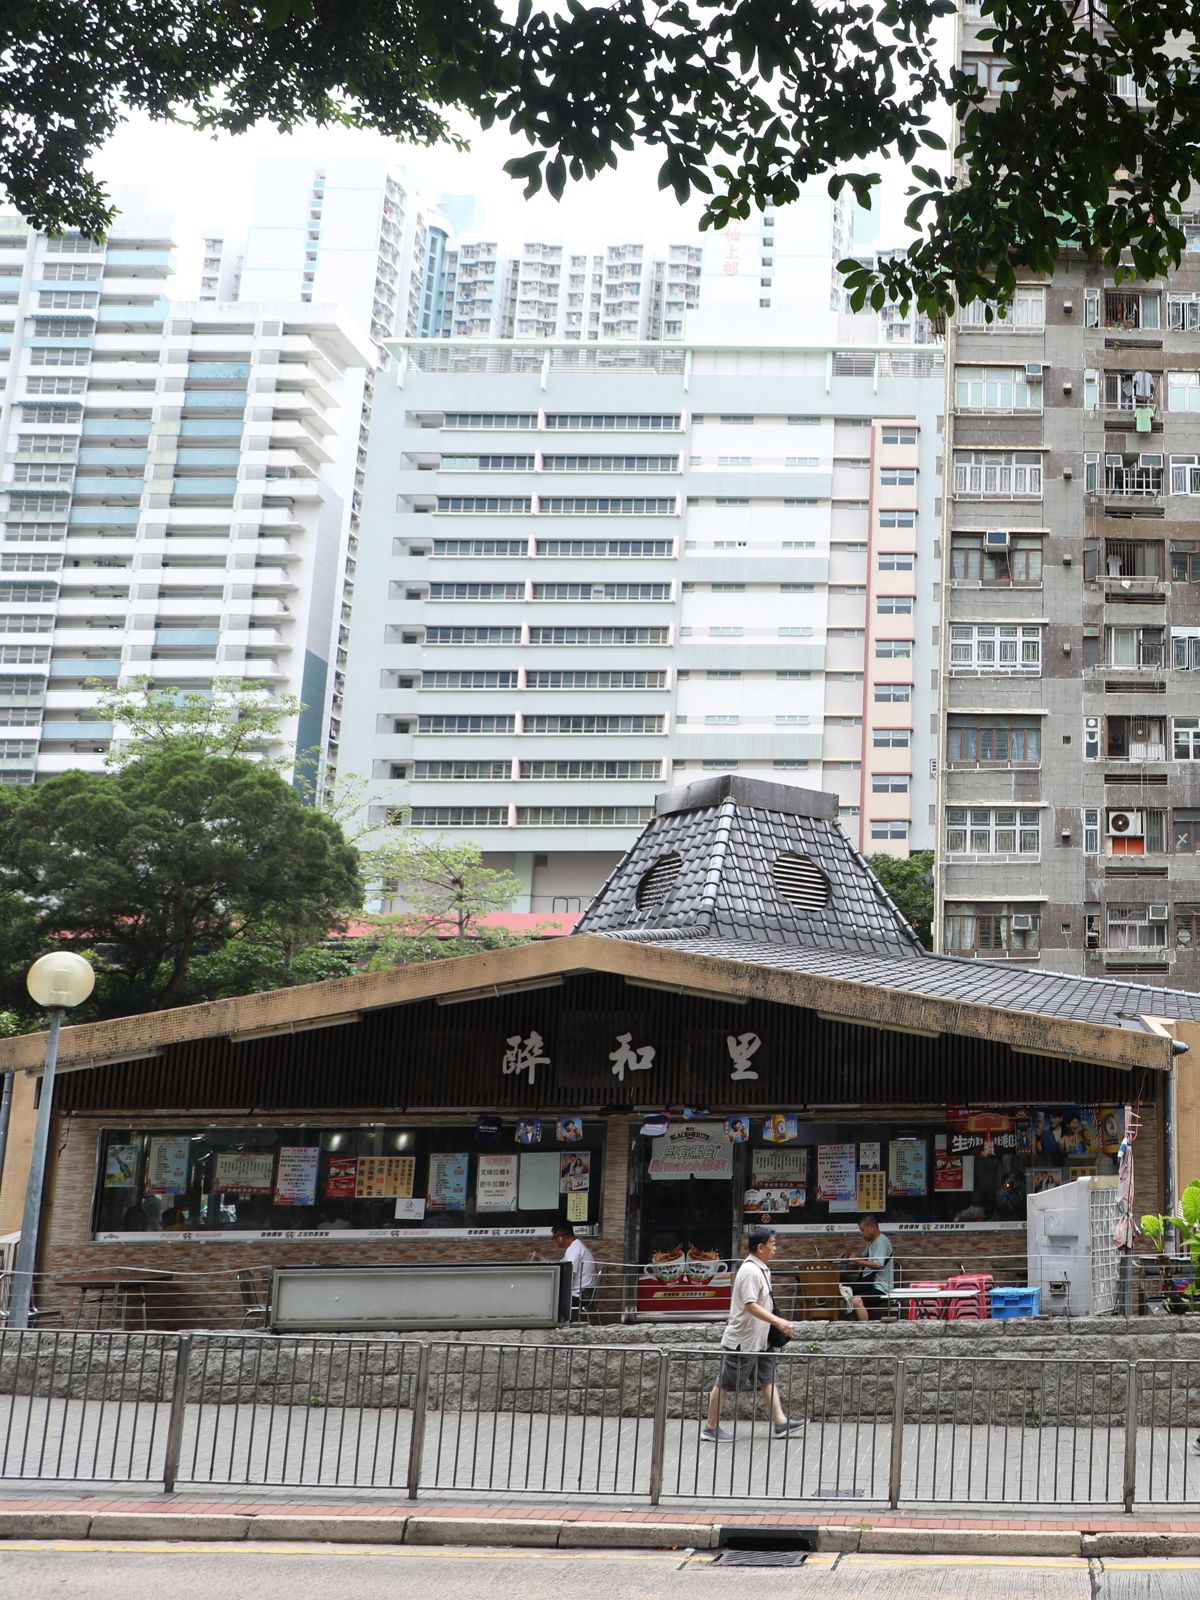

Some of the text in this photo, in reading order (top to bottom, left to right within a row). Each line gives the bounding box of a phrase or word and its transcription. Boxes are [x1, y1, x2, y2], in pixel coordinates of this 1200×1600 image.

[723, 219, 741, 277] 仙上邨
[502, 1030, 762, 1085] 醉和里
